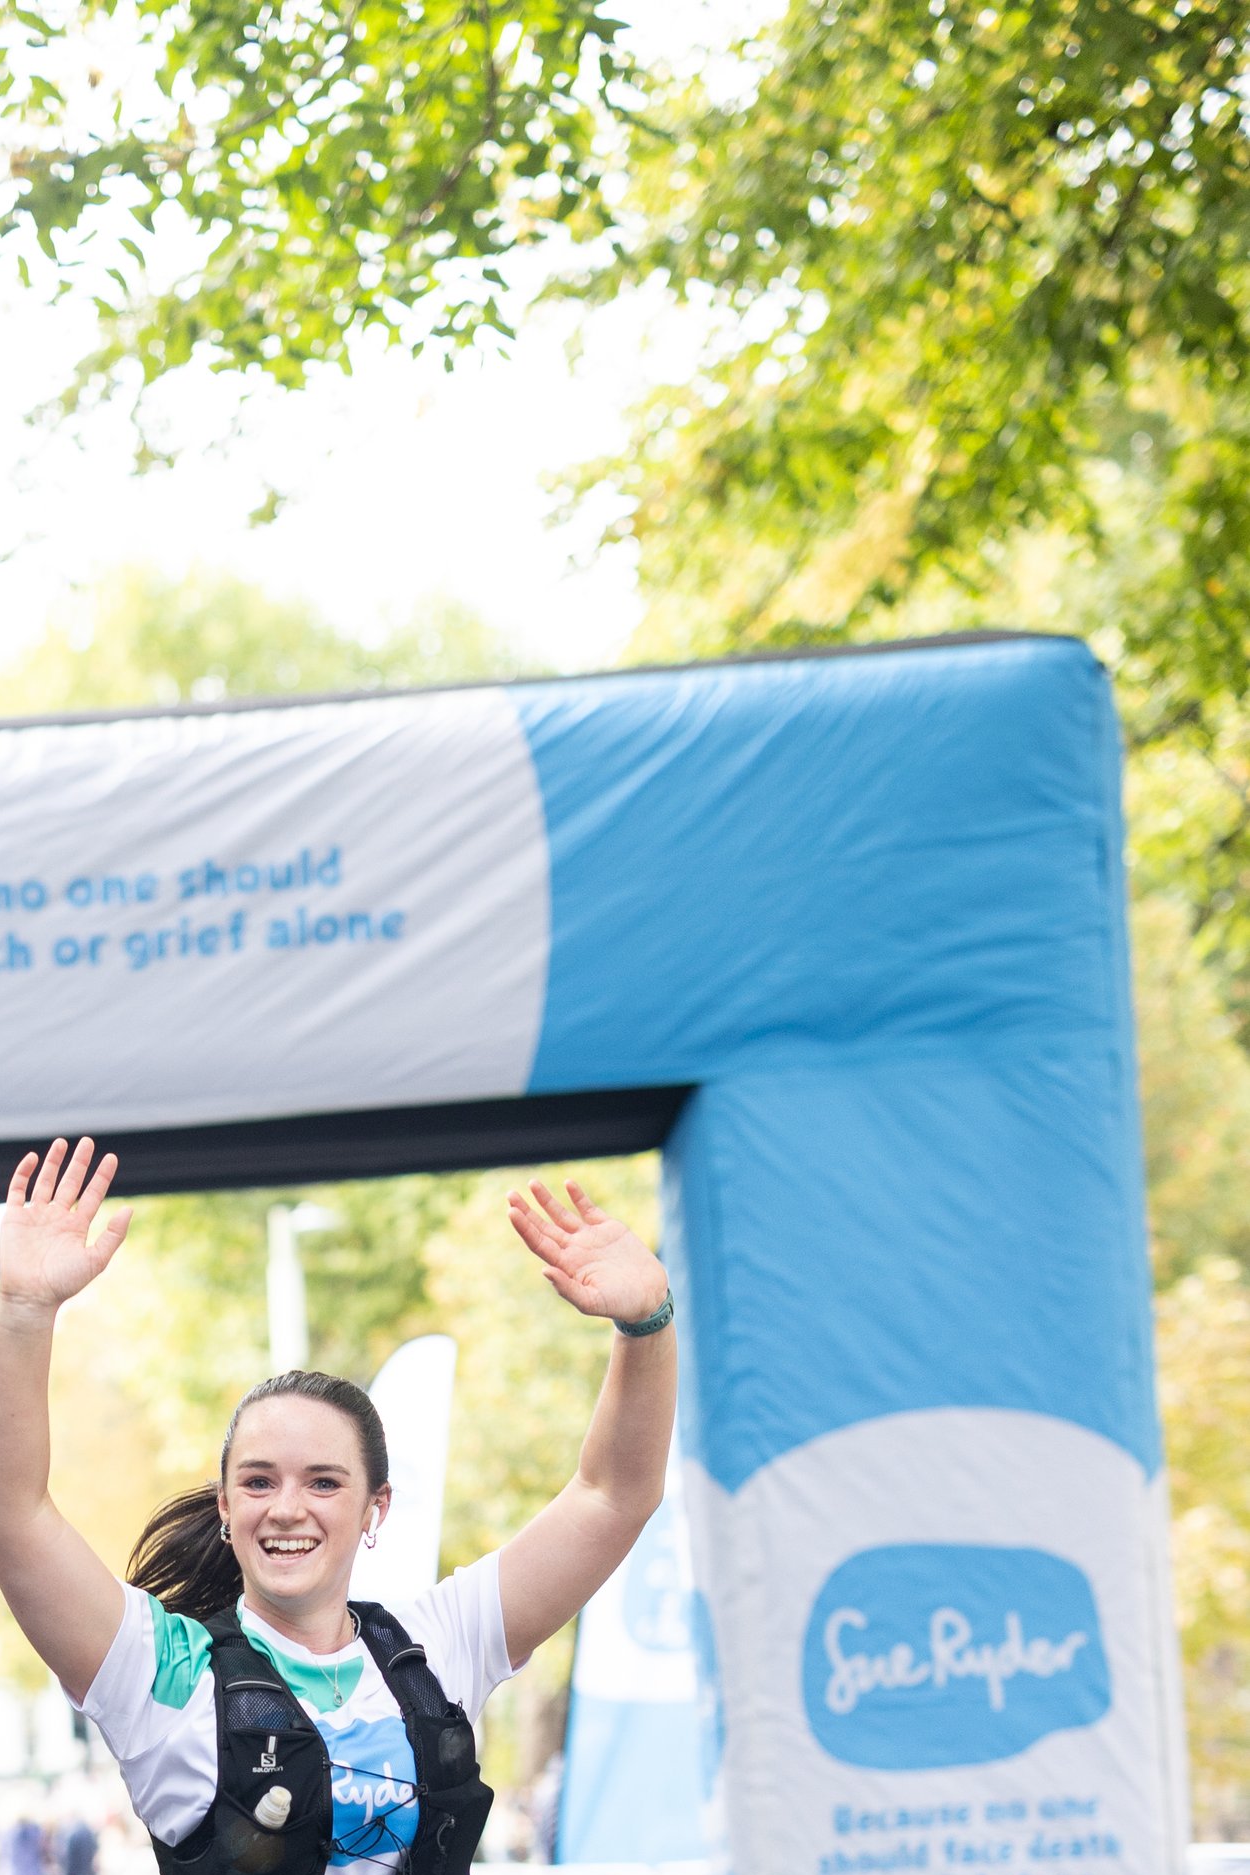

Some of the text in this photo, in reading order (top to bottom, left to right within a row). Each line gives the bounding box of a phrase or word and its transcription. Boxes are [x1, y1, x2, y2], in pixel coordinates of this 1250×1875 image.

[65, 868, 161, 910] one
[178, 846, 342, 898] should
[53, 935, 107, 968] or
[124, 910, 246, 970] grief
[264, 907, 408, 951] alone
[824, 1607, 1088, 1715] Sue Ryder
[330, 1759, 418, 1825] Ryde
[833, 1797, 1097, 1835] Because no one
[944, 1838, 1013, 1865] face
[1028, 1833, 1123, 1862] death
